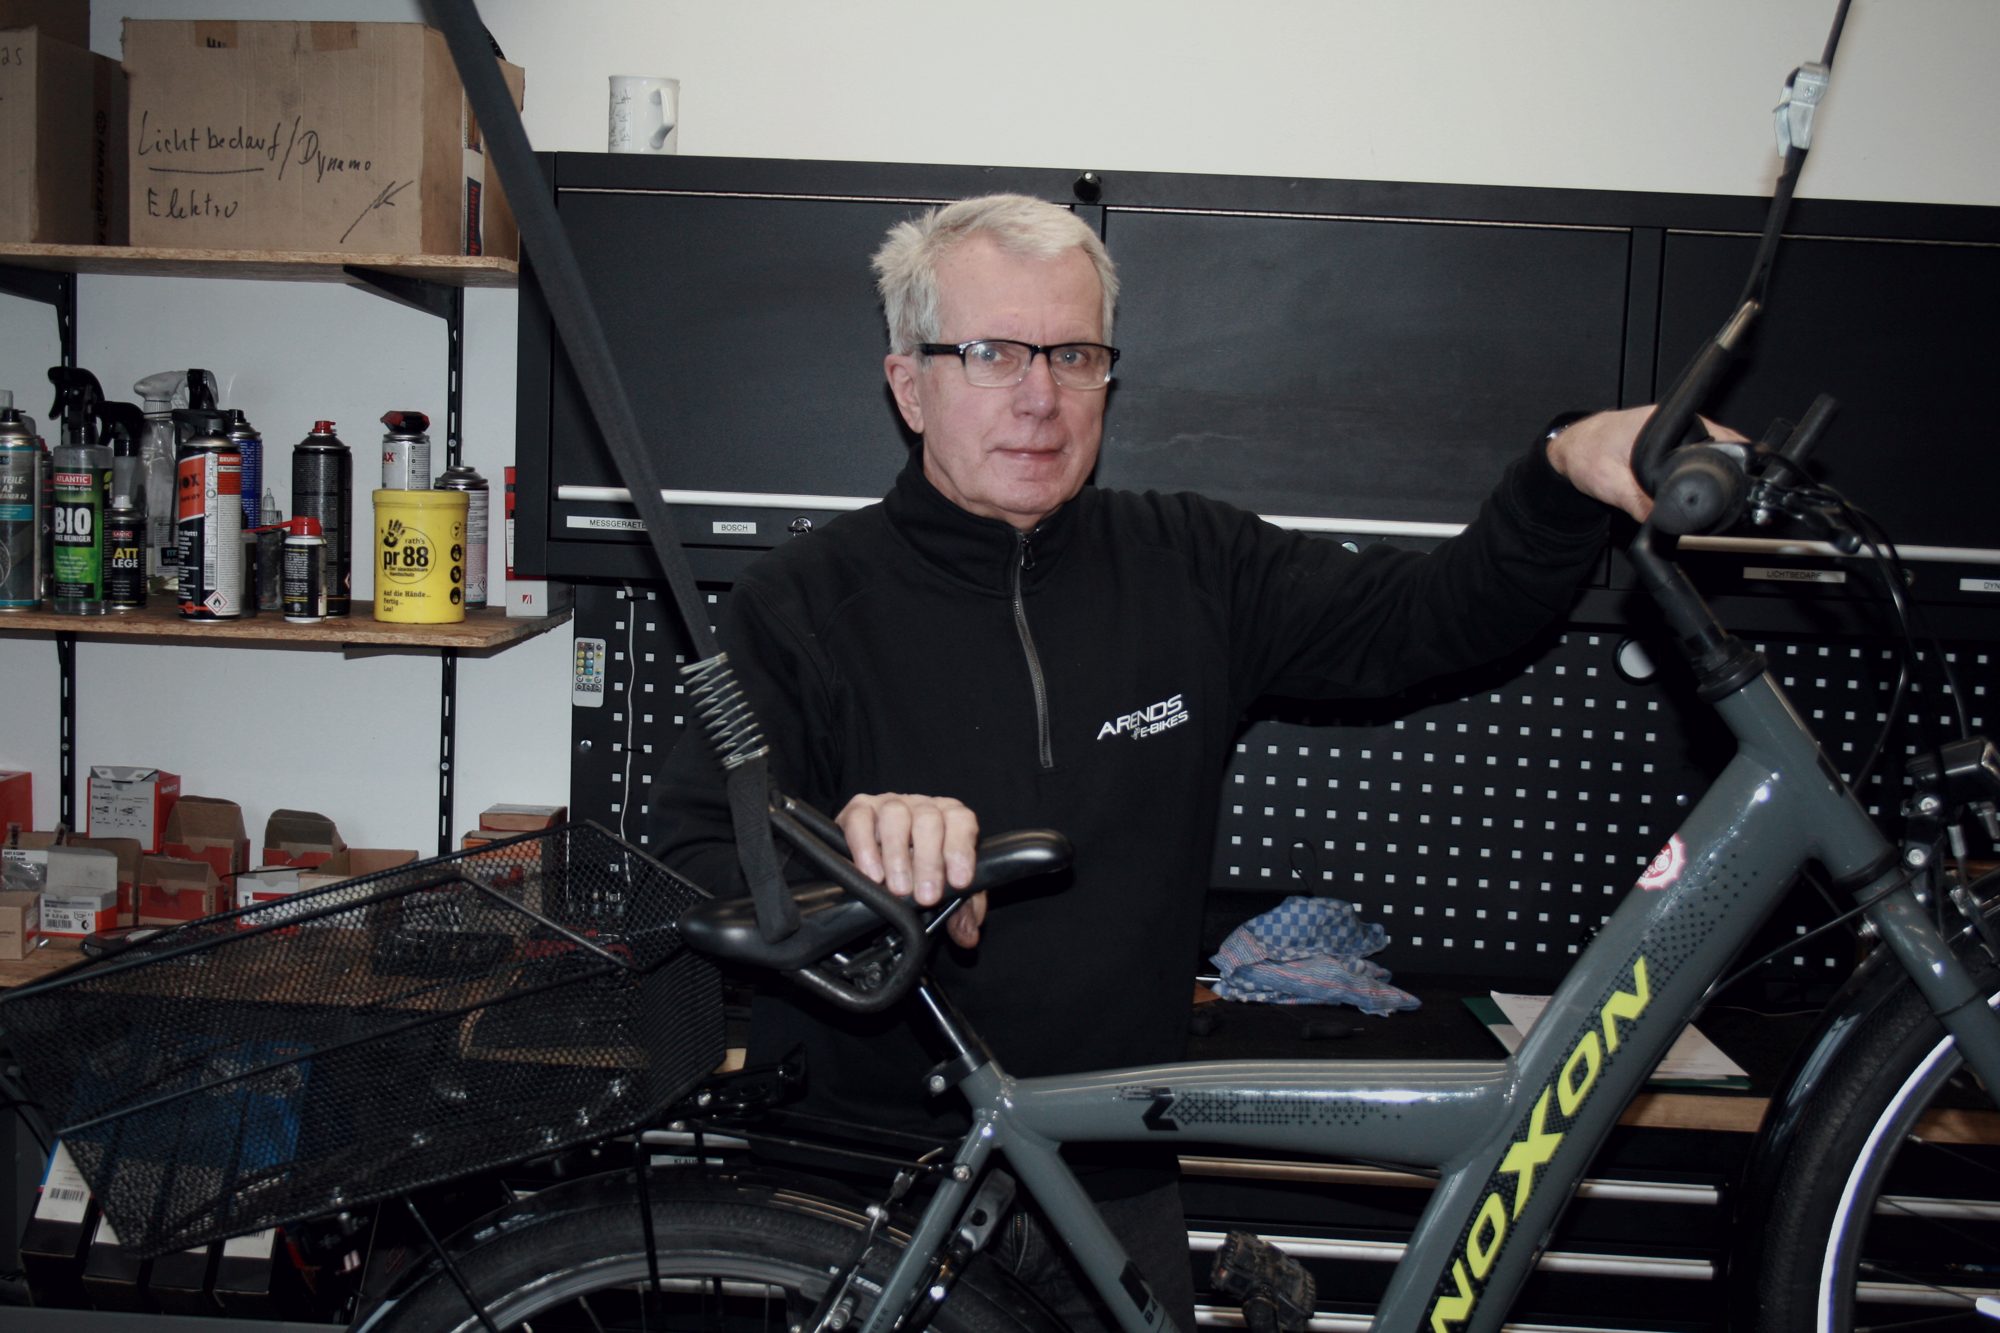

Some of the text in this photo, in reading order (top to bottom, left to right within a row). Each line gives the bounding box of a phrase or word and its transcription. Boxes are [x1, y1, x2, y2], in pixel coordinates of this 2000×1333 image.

[57, 475, 89, 484] ATLANTIC
[55, 507, 92, 535] BIO
[112, 559, 138, 568] LEGE
[113, 548, 138, 559] ATT
[384, 546, 429, 570] pr 88
[1097, 694, 1182, 740] ARENDS
[1430, 955, 1652, 1333] NOXON
